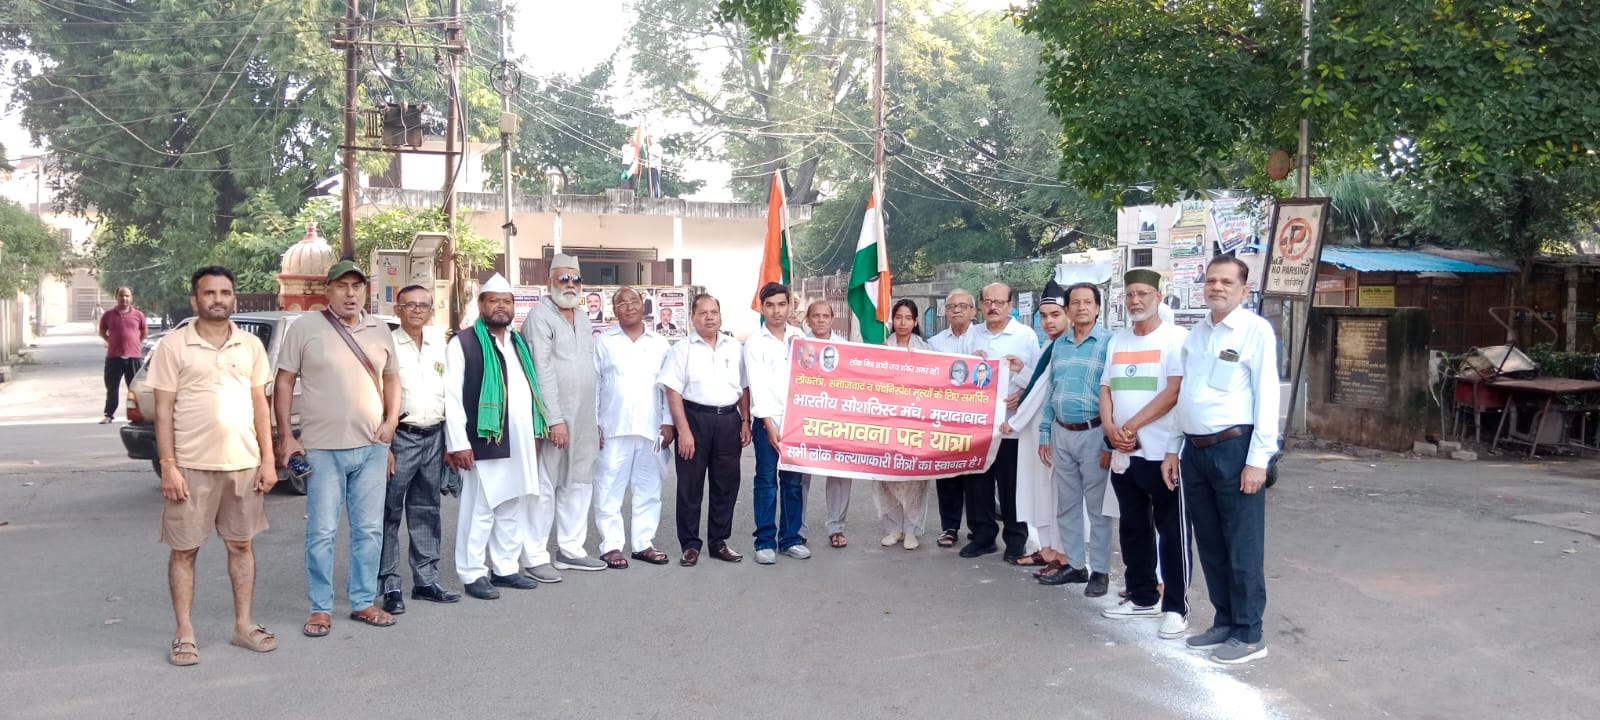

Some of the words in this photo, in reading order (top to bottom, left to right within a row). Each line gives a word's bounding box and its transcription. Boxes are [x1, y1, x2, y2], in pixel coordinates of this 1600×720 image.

[1271, 265, 1281, 274] NO
[1282, 265, 1310, 276] PARKING
[829, 379, 865, 391] समाजवाद
[867, 383, 873, 391] व
[934, 390, 943, 399] के
[944, 389, 960, 401] लिए
[793, 391, 839, 410] भारतीय
[841, 396, 899, 416] सोशलिस्ट
[930, 408, 988, 427] मुरादाबाद
[803, 416, 893, 445] सदभावना
[896, 427, 926, 449] पद
[929, 431, 973, 453] यात्रा
[786, 442, 807, 459] सभी
[808, 445, 833, 461] लोक
[833, 451, 892, 469] कल्याणकारी
[893, 452, 918, 471] मित्रों
[918, 459, 932, 471] का
[934, 460, 968, 471] स्वागत
